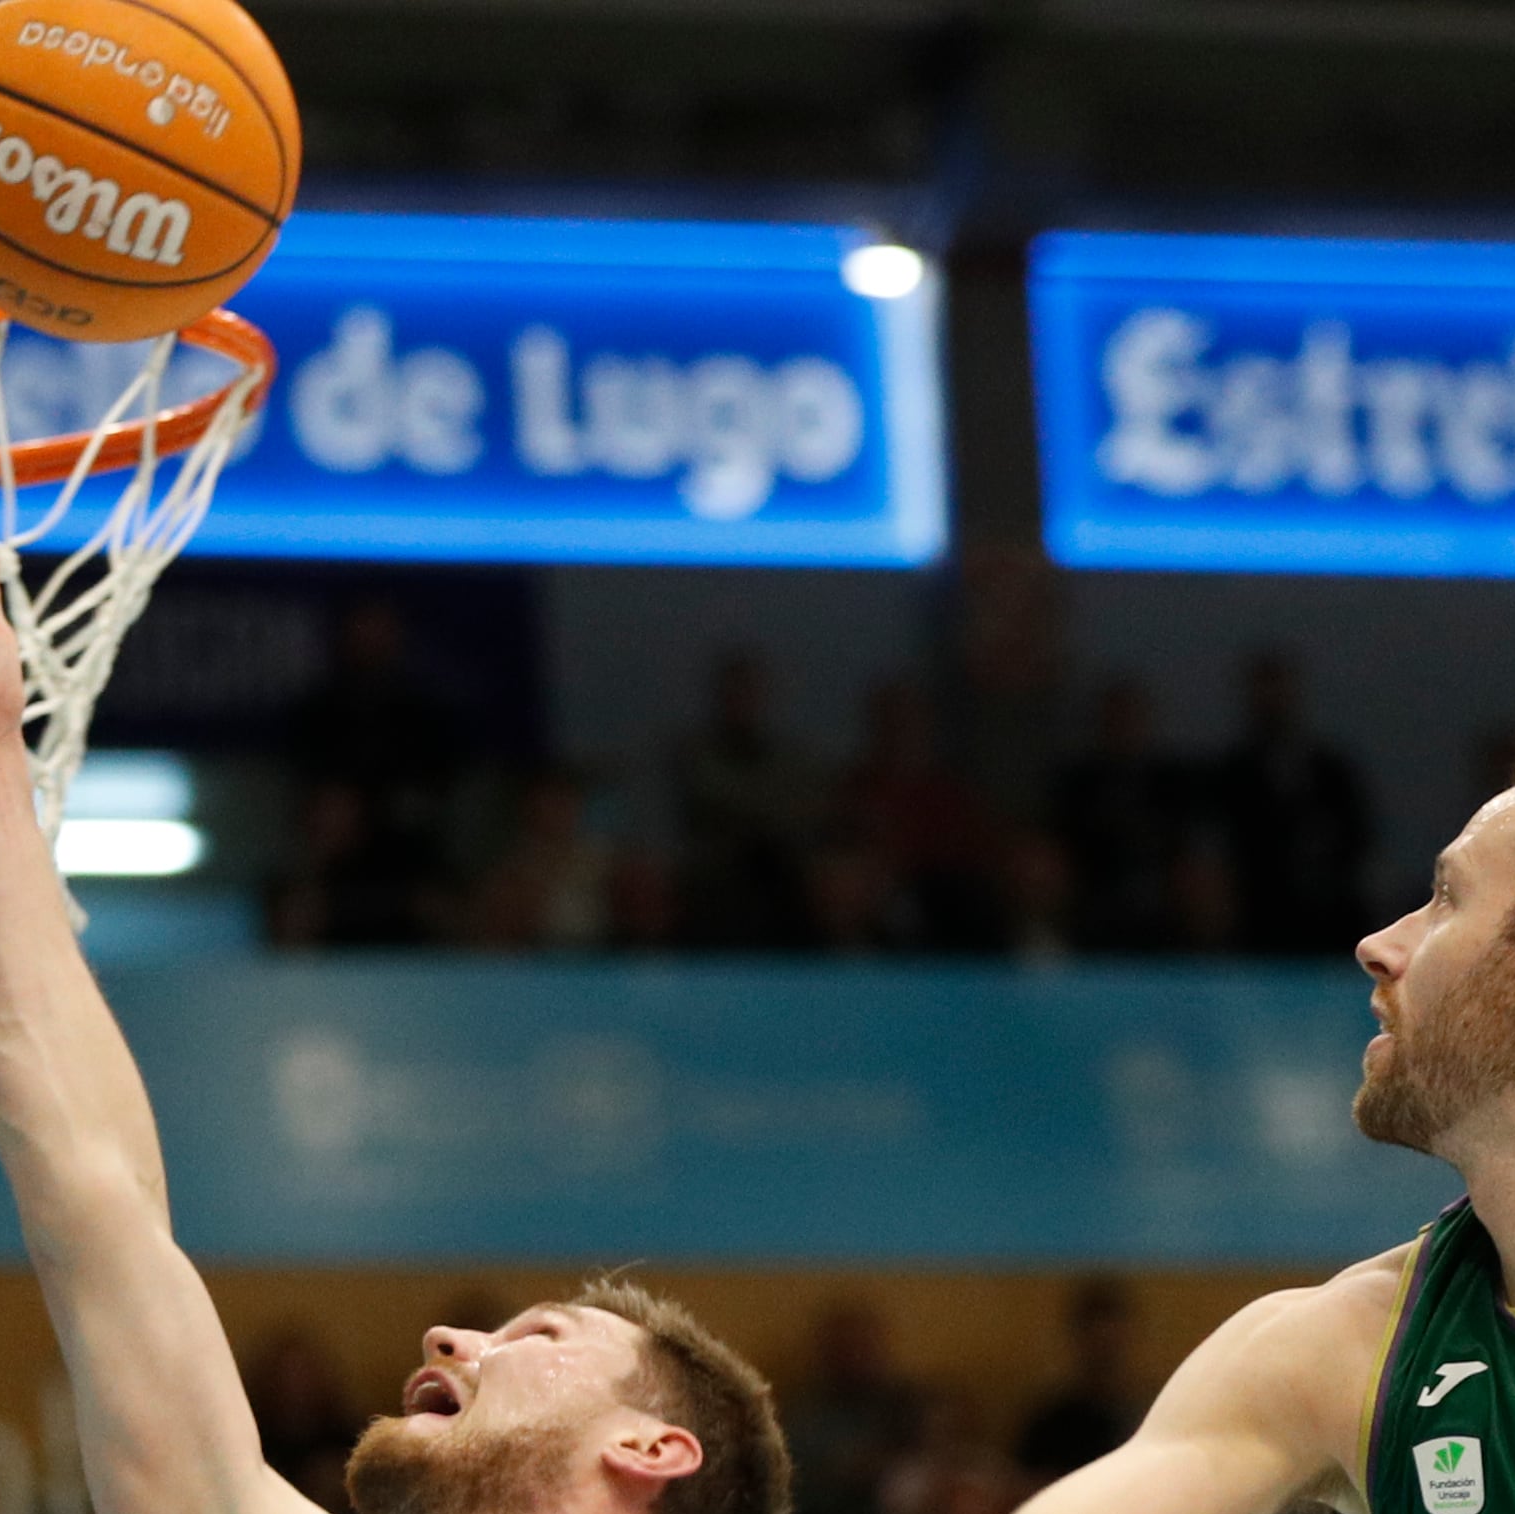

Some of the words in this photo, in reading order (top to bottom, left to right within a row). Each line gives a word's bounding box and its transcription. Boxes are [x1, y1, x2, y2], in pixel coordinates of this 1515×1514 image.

[166, 70, 232, 141] liga
[294, 302, 484, 475] de
[512, 324, 865, 521] Lugo
